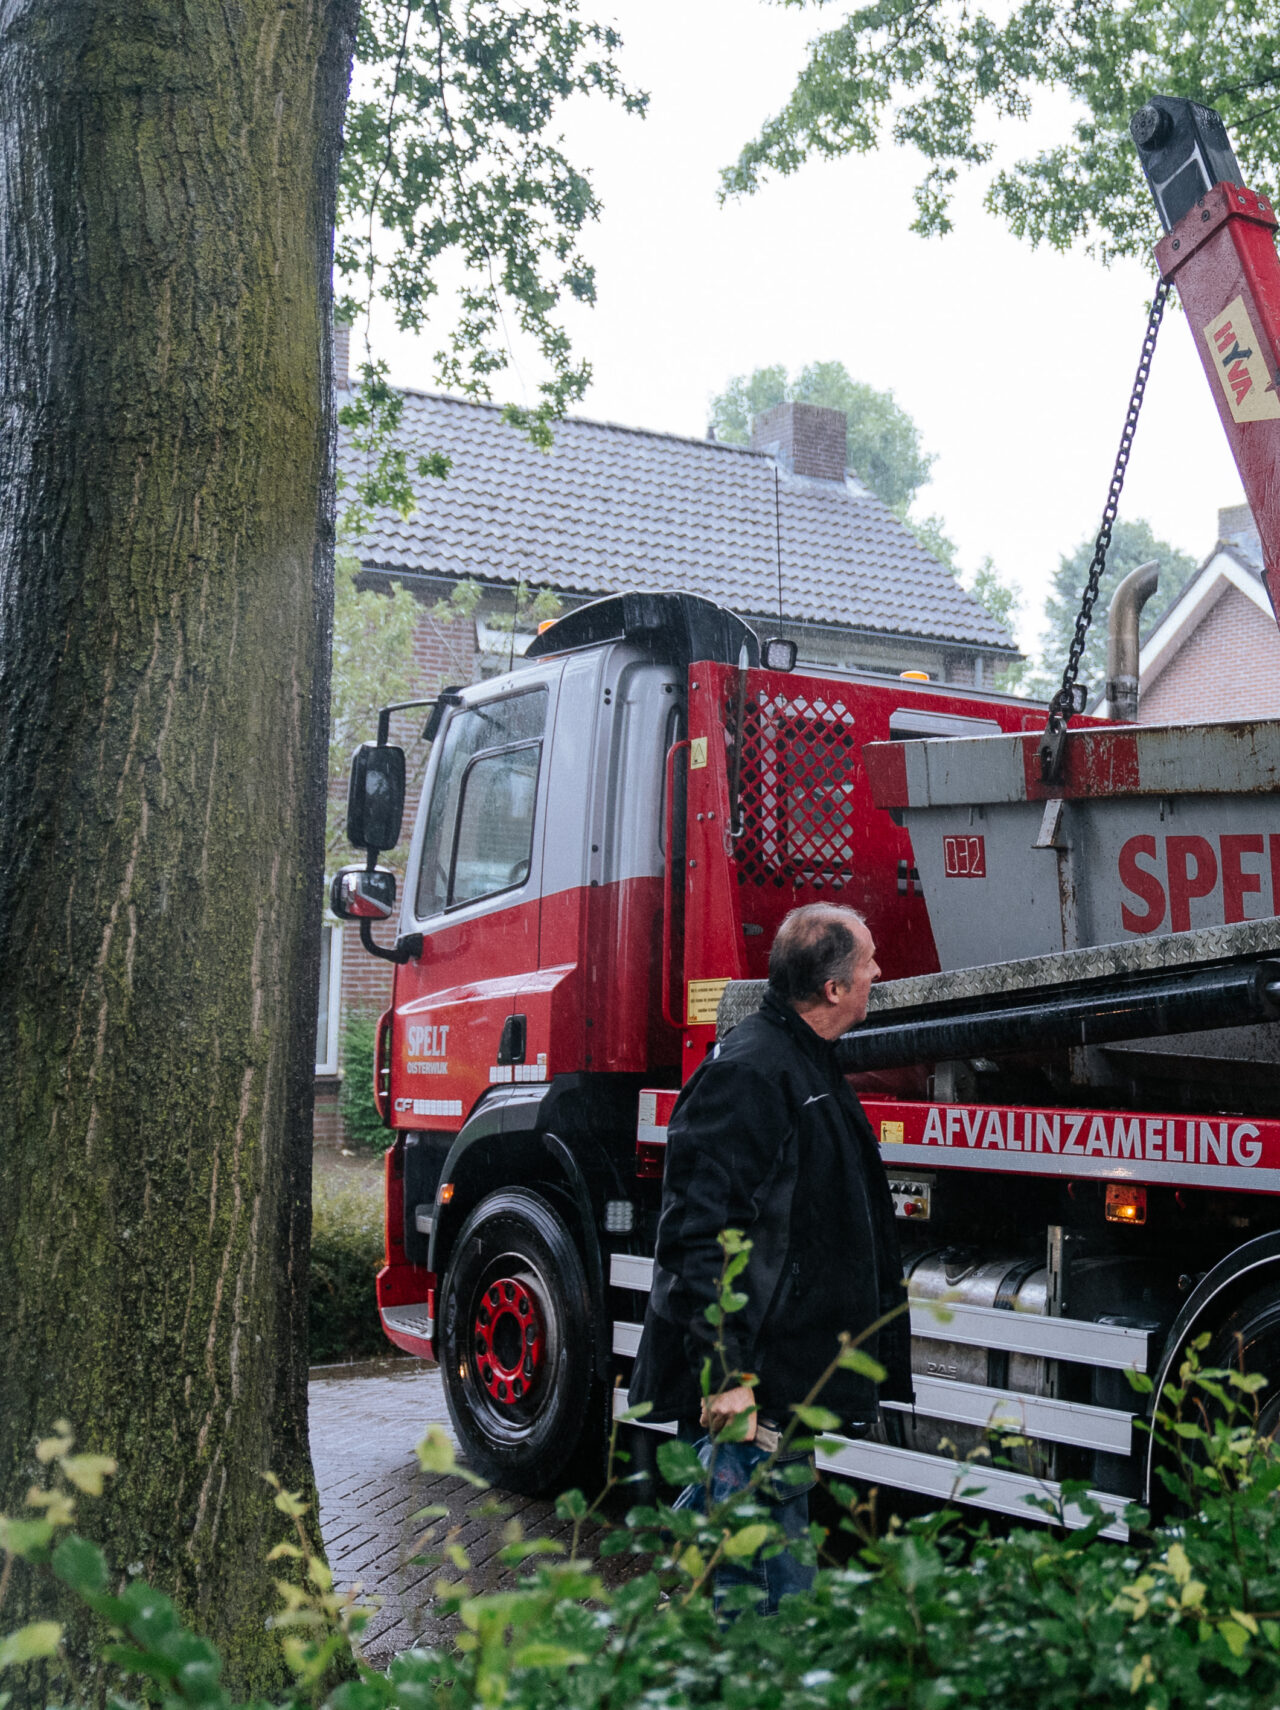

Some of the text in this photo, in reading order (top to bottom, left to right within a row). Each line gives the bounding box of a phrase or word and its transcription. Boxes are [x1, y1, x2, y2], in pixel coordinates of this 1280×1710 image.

[1213, 320, 1253, 406] HYVA
[945, 838, 983, 874] 032
[407, 1025, 450, 1057] SPELT
[394, 1098, 413, 1112] CF
[922, 1107, 1263, 1167] AFVALINZAMELING
[927, 1362, 957, 1377] DAF
